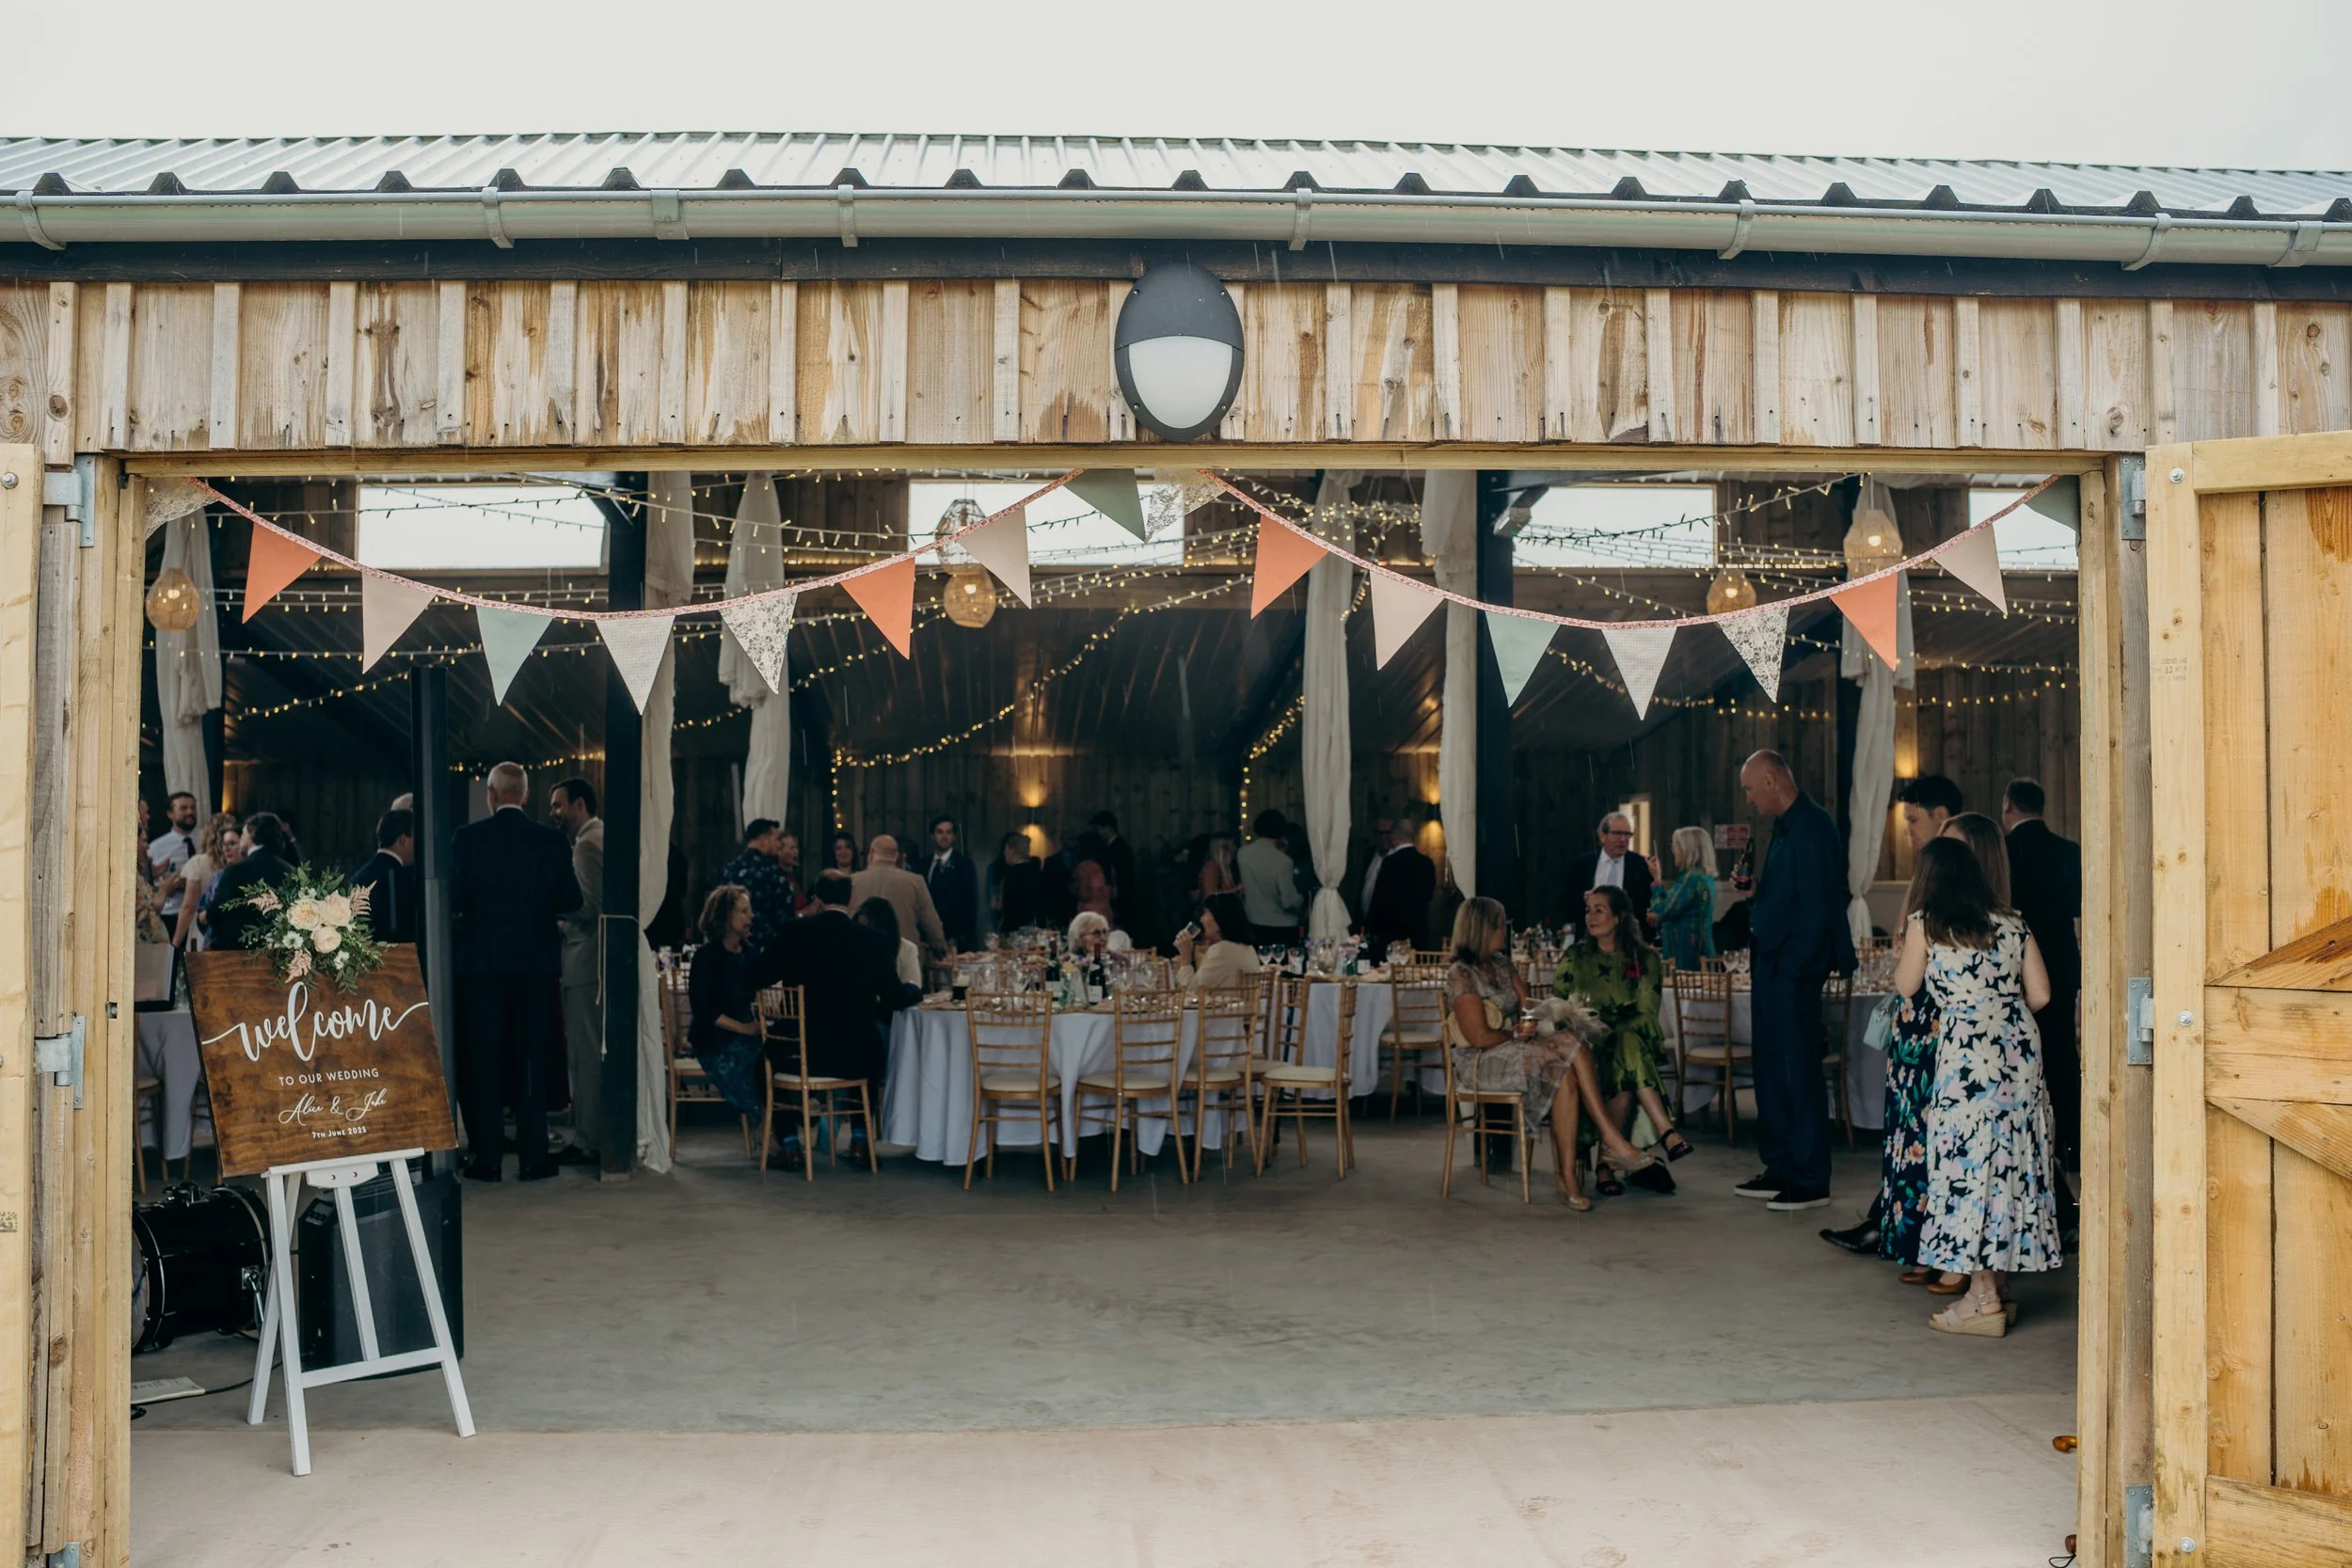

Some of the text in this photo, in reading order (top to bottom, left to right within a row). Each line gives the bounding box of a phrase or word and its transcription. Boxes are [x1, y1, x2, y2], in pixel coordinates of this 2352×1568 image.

[201, 981, 429, 1062] welcome
[278, 1068, 379, 1085] TO OUR WEDDING
[278, 1093, 324, 1126] Alice
[330, 1096, 344, 1116] &
[348, 1126, 367, 1134] 2025
